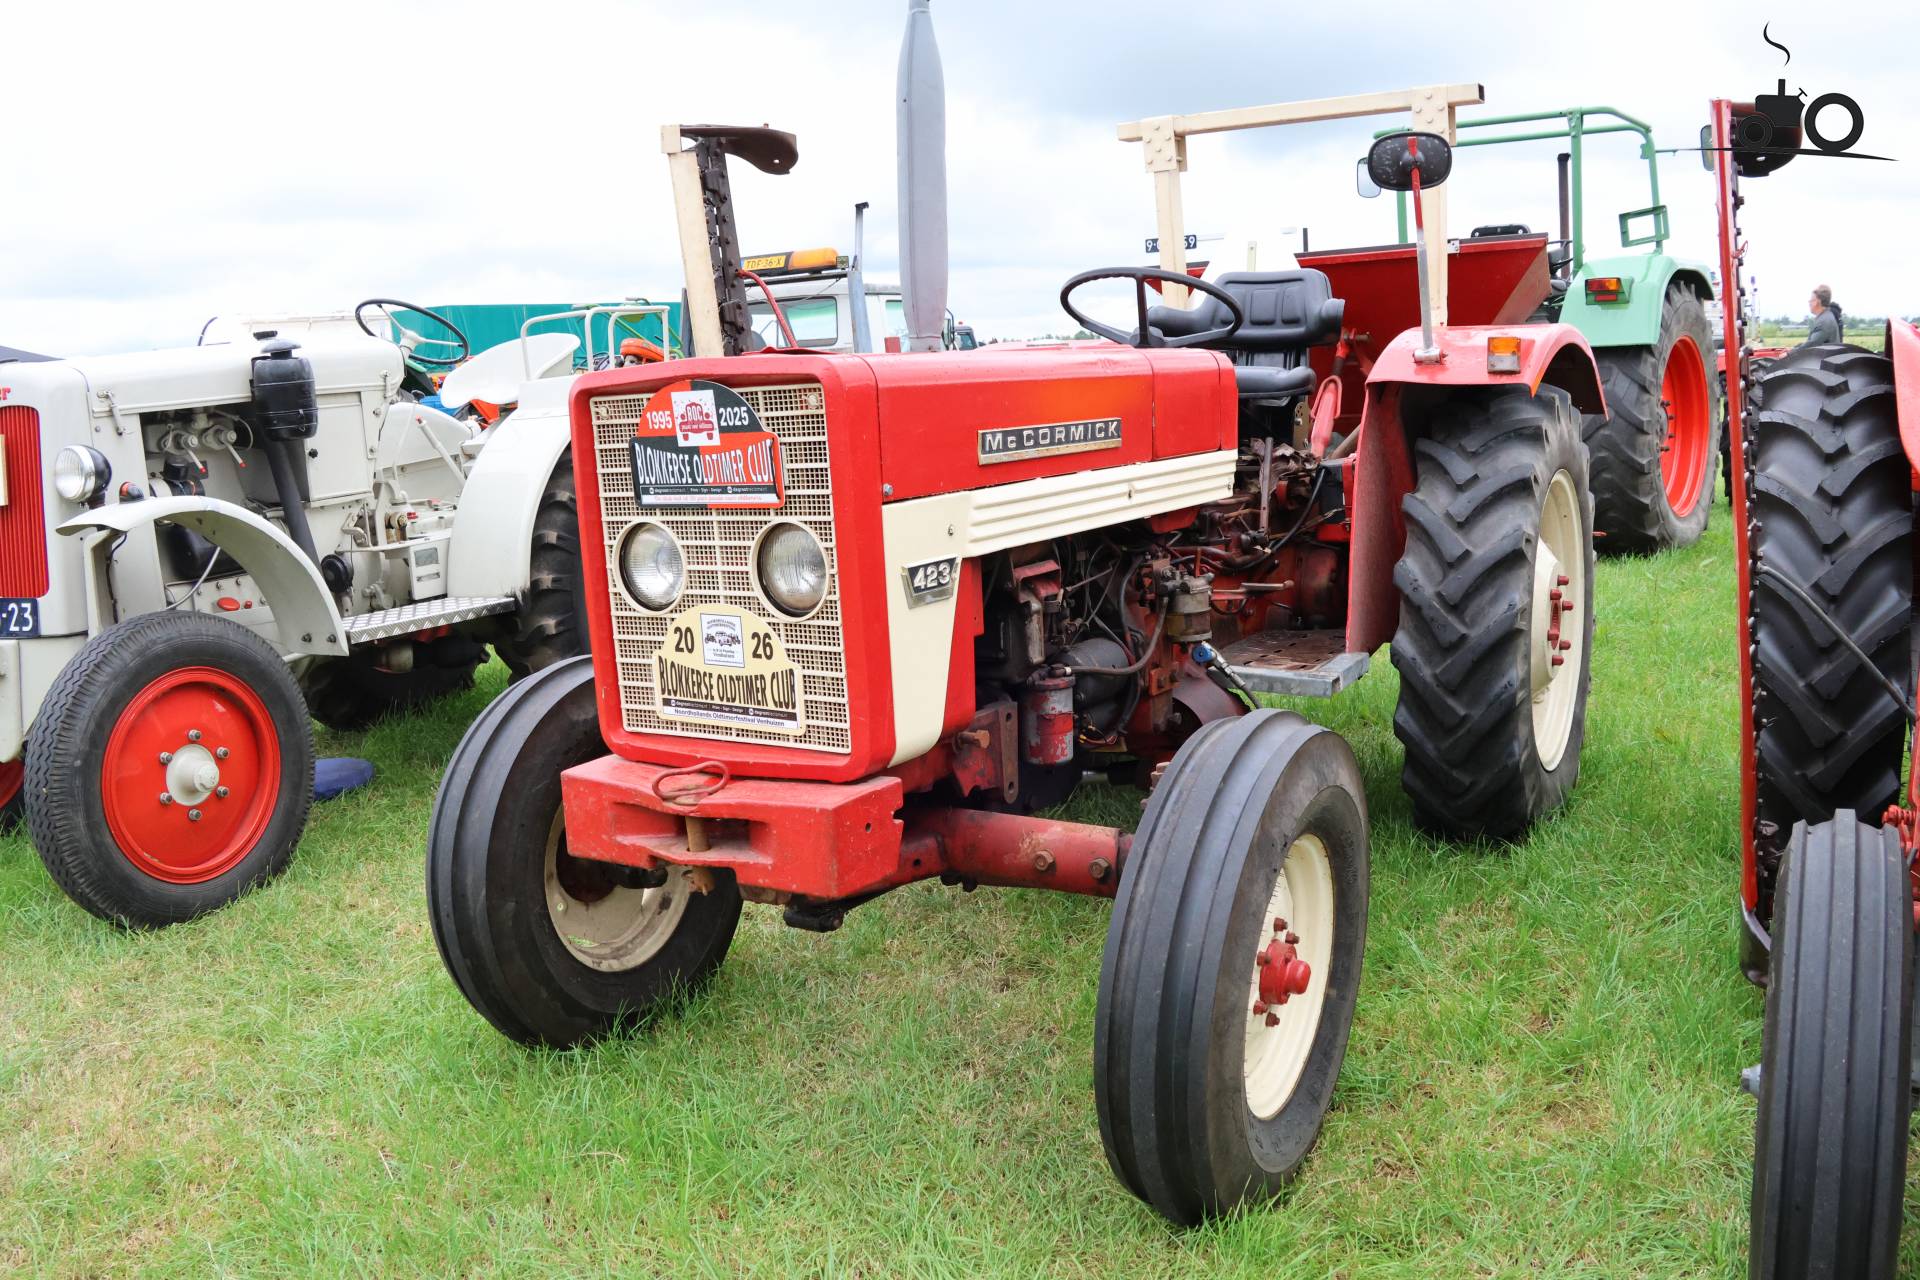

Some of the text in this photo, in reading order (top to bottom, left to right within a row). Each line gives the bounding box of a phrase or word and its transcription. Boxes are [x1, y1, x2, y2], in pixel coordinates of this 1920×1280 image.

[646, 410, 673, 429] 1995
[686, 405, 703, 421] BOC
[718, 406, 749, 427] 2025
[634, 442, 693, 485] BLOKKERSE
[693, 448, 746, 484] OLDTIMER
[913, 561, 951, 589] 423
[673, 626, 695, 654] 20
[751, 631, 774, 661] 26
[658, 655, 797, 710] BLOKKERSE OLDTIMER CLUB
